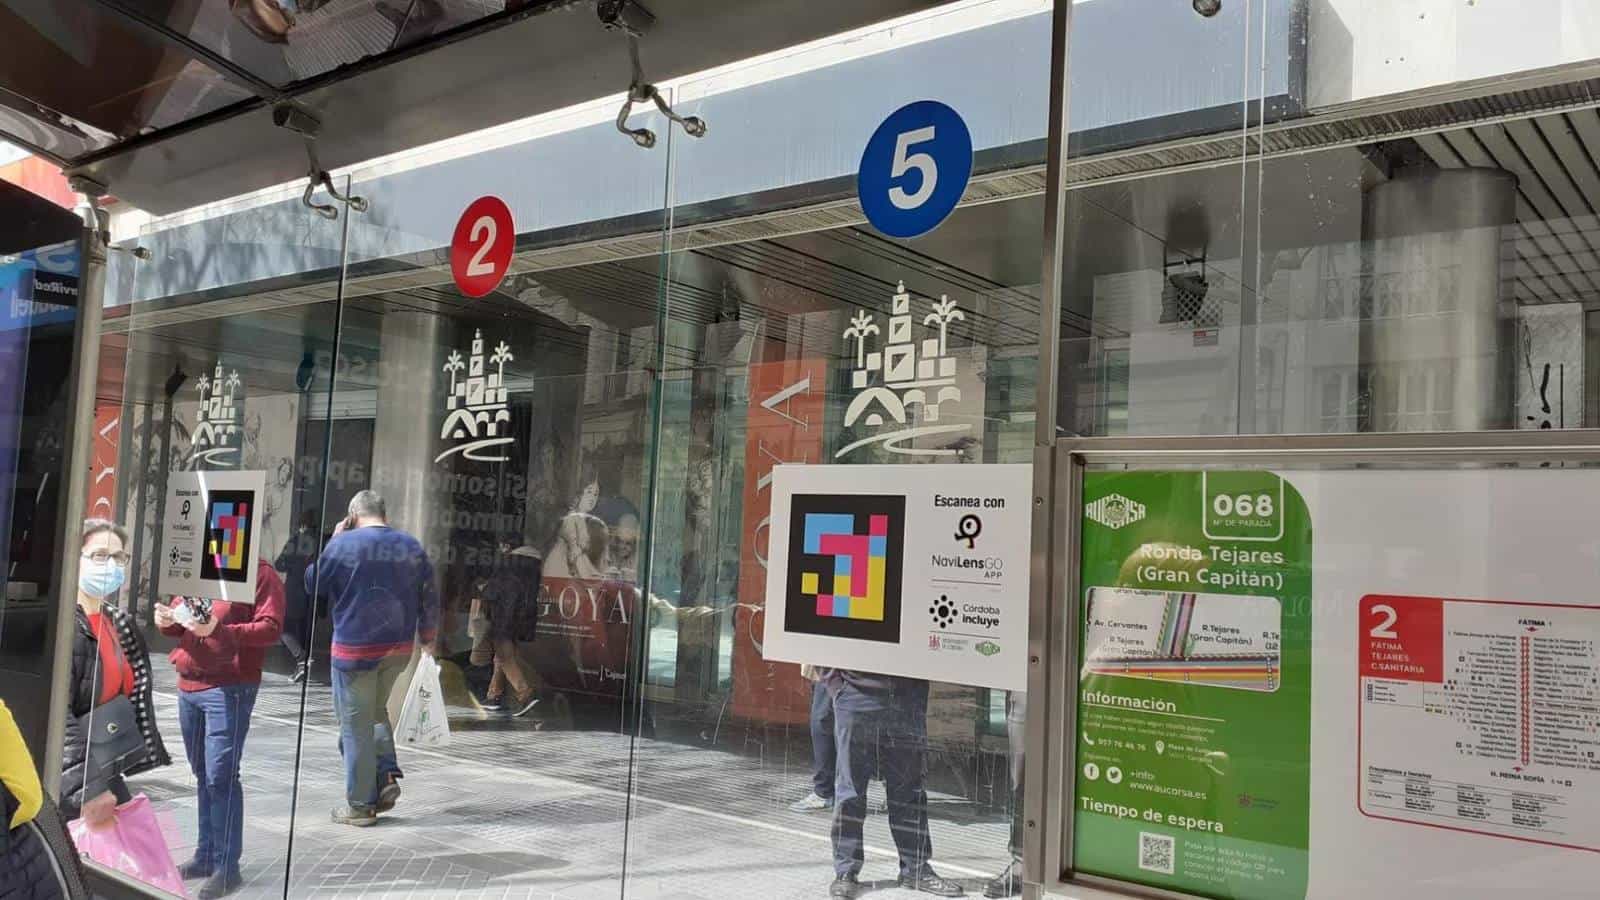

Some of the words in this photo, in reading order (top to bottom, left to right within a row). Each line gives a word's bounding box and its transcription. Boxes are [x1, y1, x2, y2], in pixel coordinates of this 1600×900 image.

[887, 125, 938, 211] 5
[465, 215, 498, 278] 2
[934, 494, 980, 507] Escanea
[984, 497, 1005, 509] con
[1213, 493, 1273, 517] 068
[931, 555, 1003, 570] NaviLensGO
[1140, 544, 1202, 560] Ronda
[1210, 545, 1284, 564] Tejares
[984, 571, 1002, 579] APP
[1137, 566, 1190, 583] (Gran
[1196, 567, 1283, 590] Capitán)
[962, 603, 1000, 615] Córdoba
[962, 614, 1000, 628] incluye
[1107, 620, 1148, 630] Cervantes
[1370, 603, 1398, 639] 2
[1371, 651, 1408, 662] TEJARES
[1082, 690, 1176, 712] Información
[1080, 796, 1138, 819] Tiempo
[1143, 807, 1163, 823] de
[1168, 812, 1224, 833] espera
